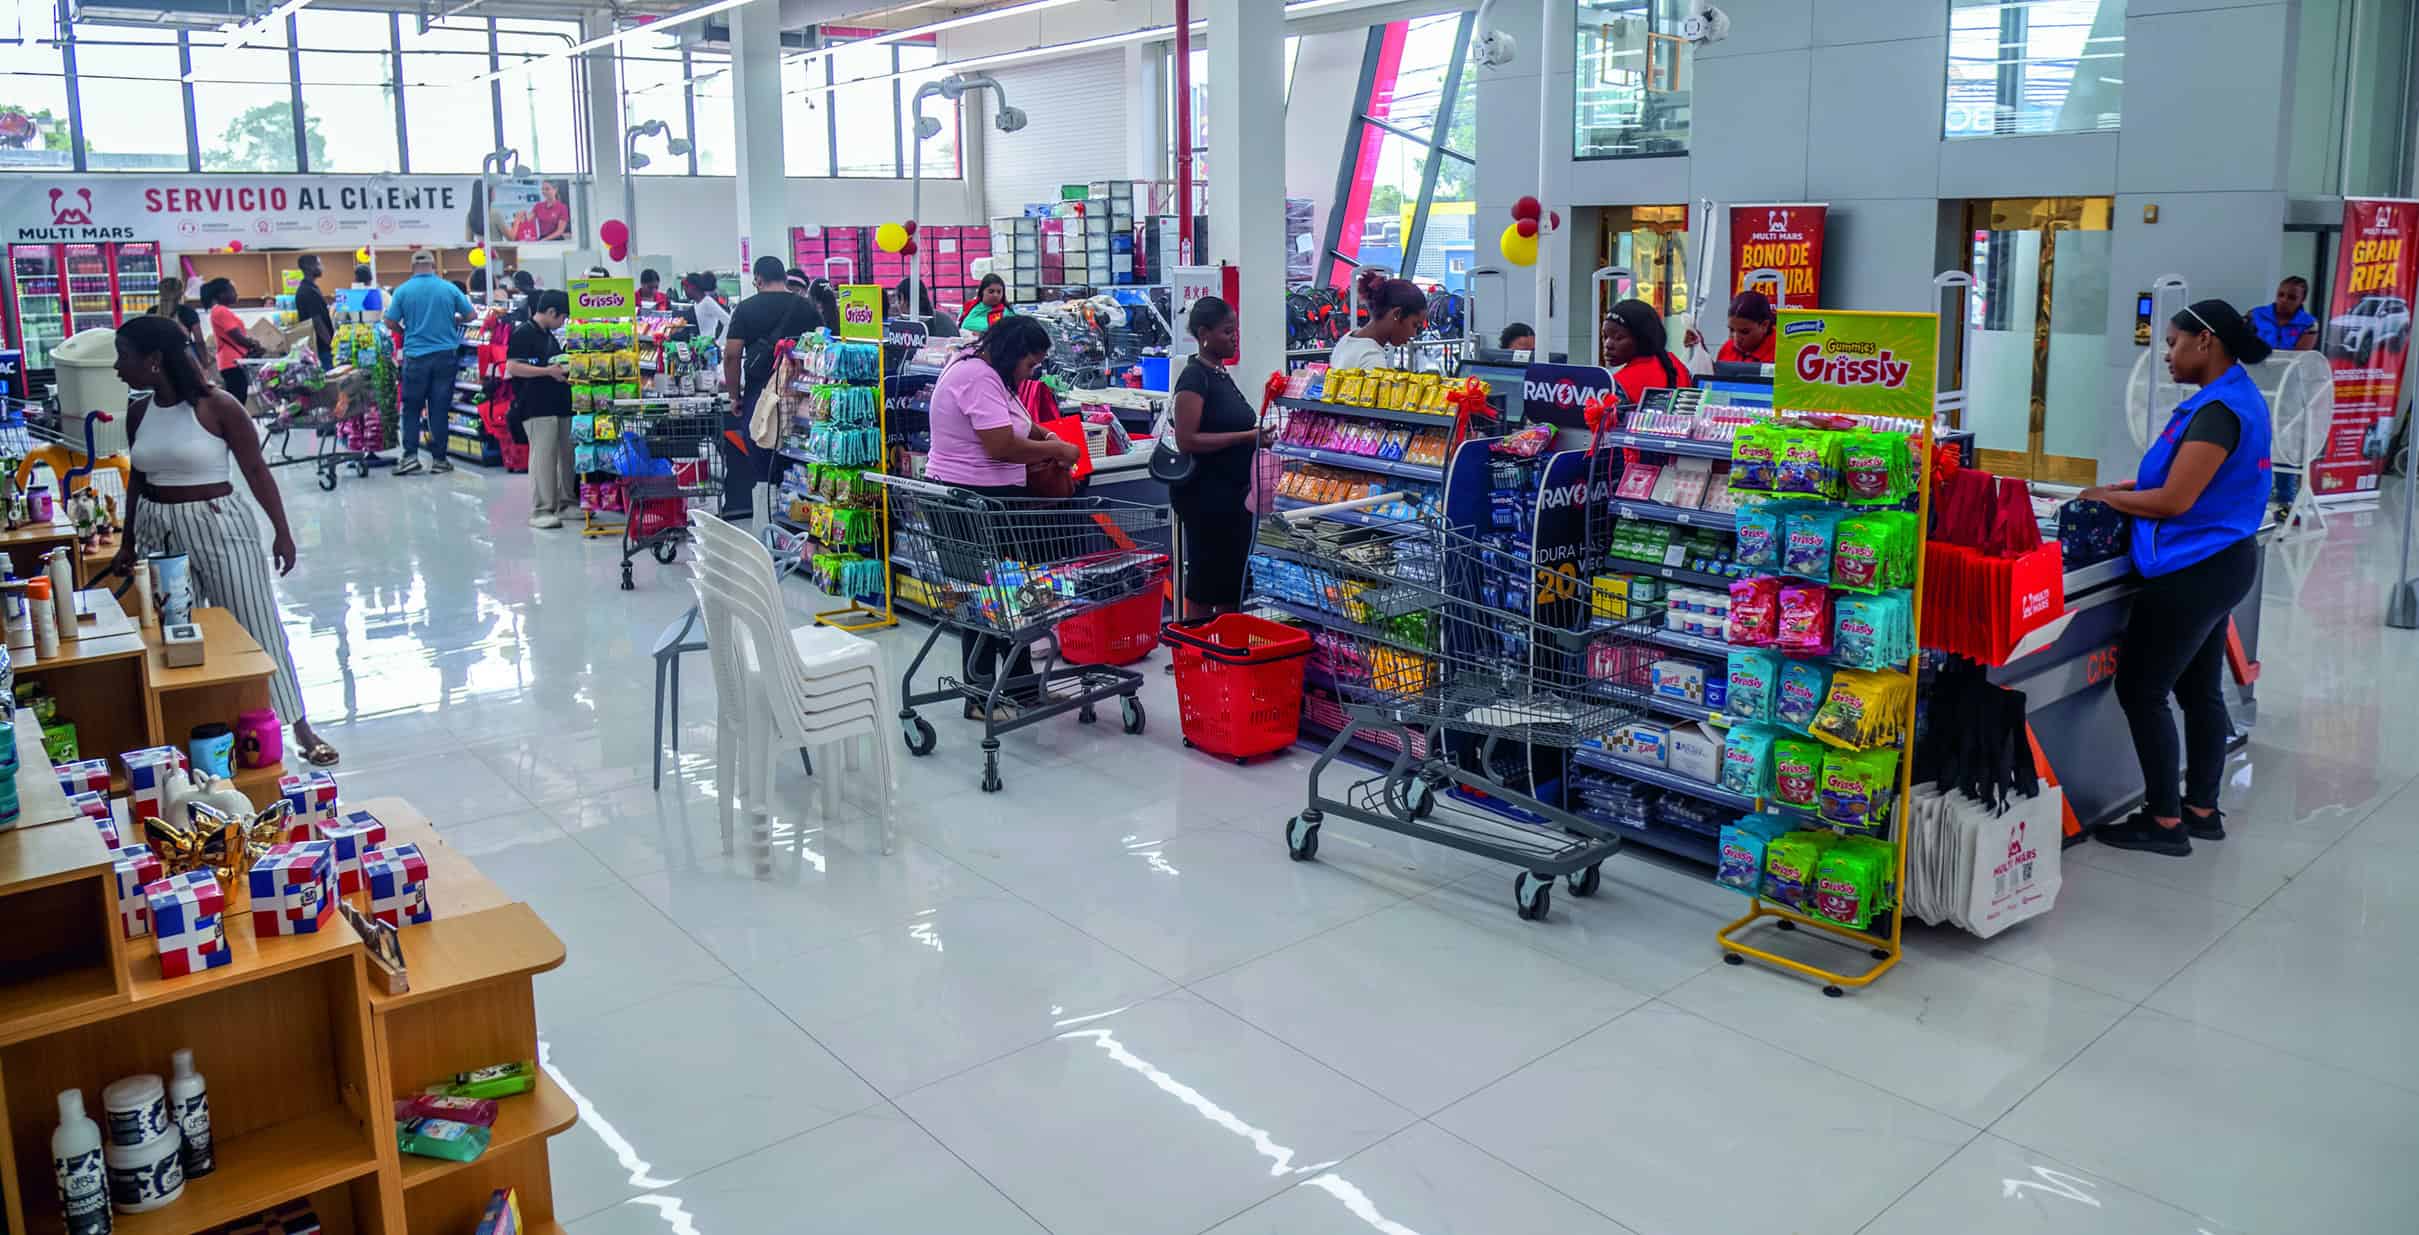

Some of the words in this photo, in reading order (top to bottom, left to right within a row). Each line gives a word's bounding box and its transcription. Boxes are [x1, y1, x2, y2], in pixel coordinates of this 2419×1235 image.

[145, 187, 288, 212] SERVICIO
[298, 188, 331, 210] AL
[18, 228, 75, 240] MULTI
[81, 227, 135, 239] MARS
[1743, 243, 1786, 268] BONO
[1790, 243, 1809, 266] DE
[2352, 239, 2402, 263] GRAN
[2348, 263, 2398, 293] RIFA
[579, 292, 625, 308] Grissly
[845, 302, 873, 324] Grissly
[889, 331, 926, 347] RAYOVAC
[1826, 338, 1876, 354] Gummies
[1796, 344, 1910, 388] Grissly
[1537, 562, 1577, 605] 20
